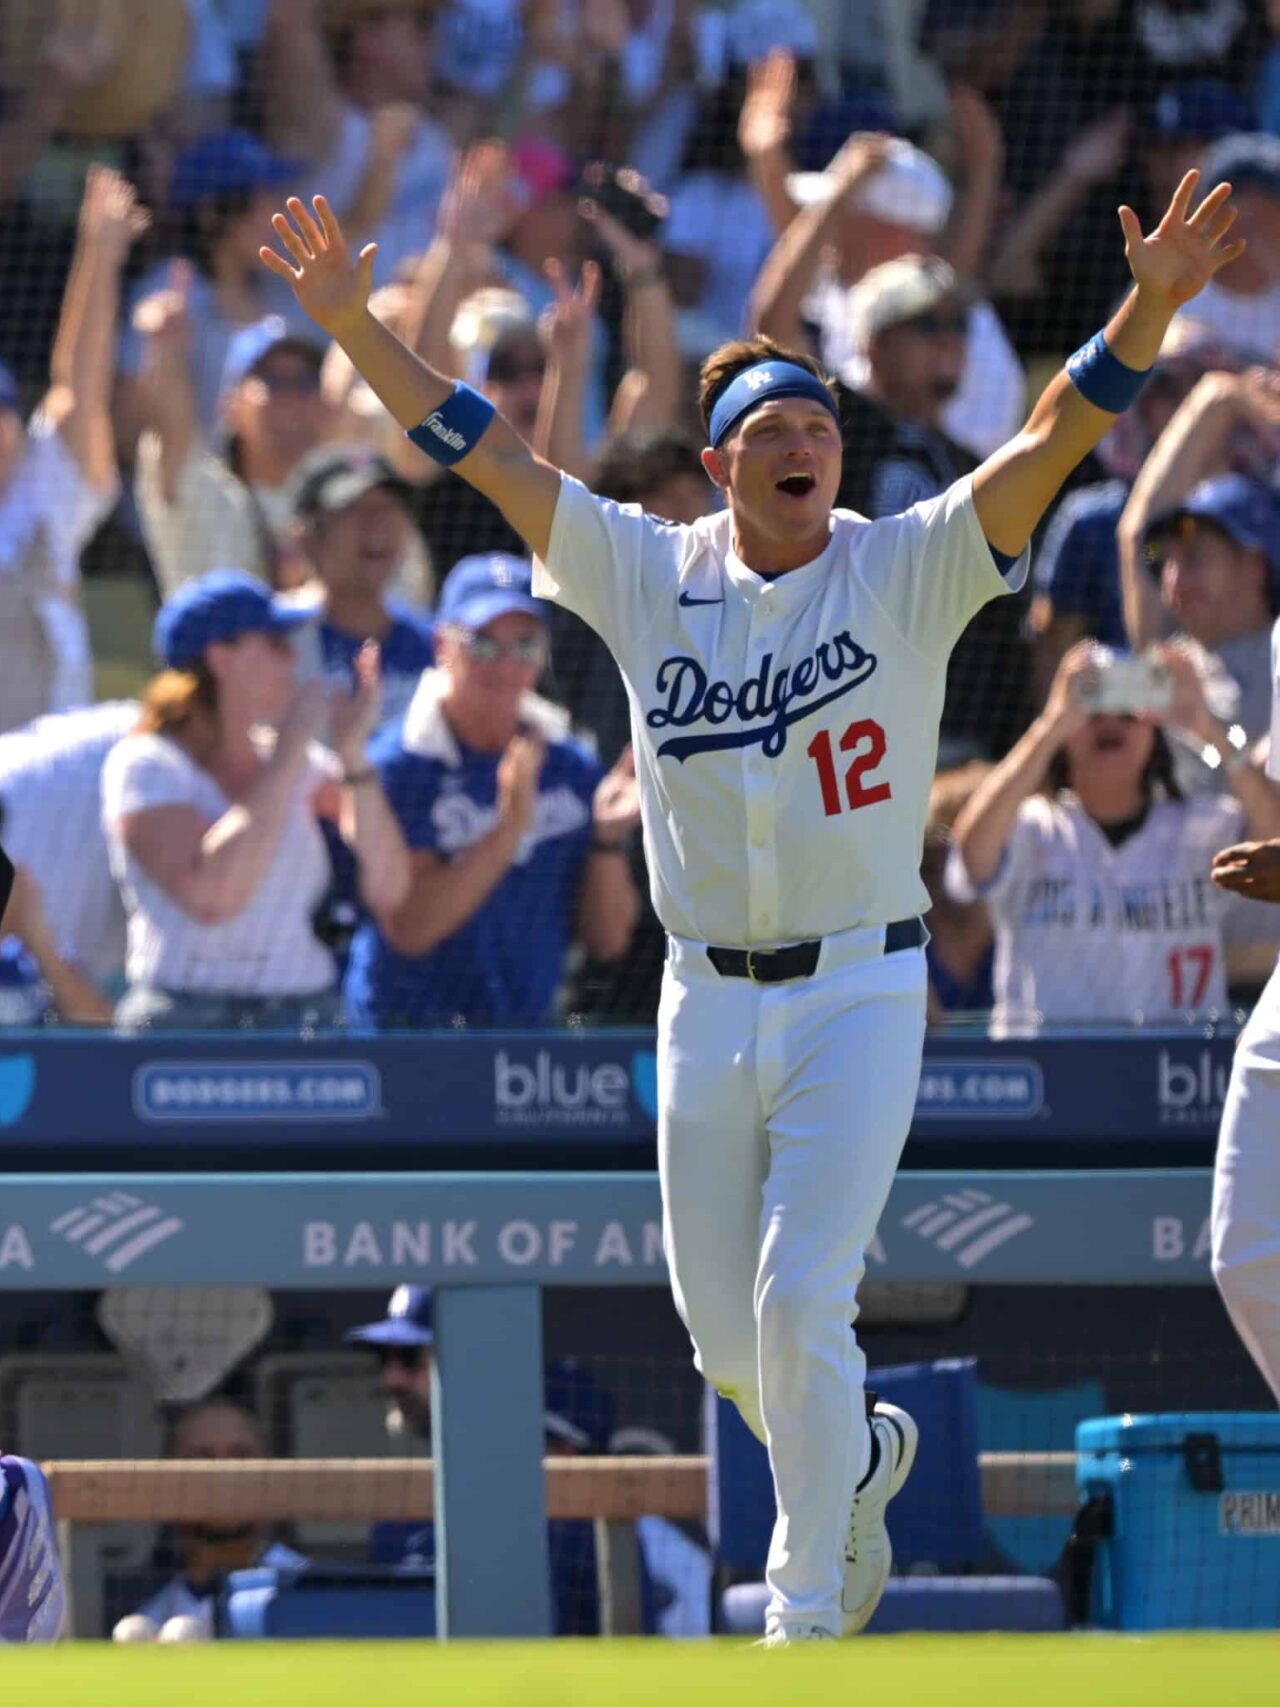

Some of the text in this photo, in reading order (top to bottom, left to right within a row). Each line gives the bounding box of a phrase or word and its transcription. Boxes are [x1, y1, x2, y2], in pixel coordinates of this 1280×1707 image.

[646, 630, 877, 765] Dodgers
[807, 718, 892, 817] 12
[1169, 945, 1215, 1010] 17
[494, 1048, 629, 1107] blue
[303, 1220, 479, 1267] BANK
[497, 1219, 579, 1266] OF
